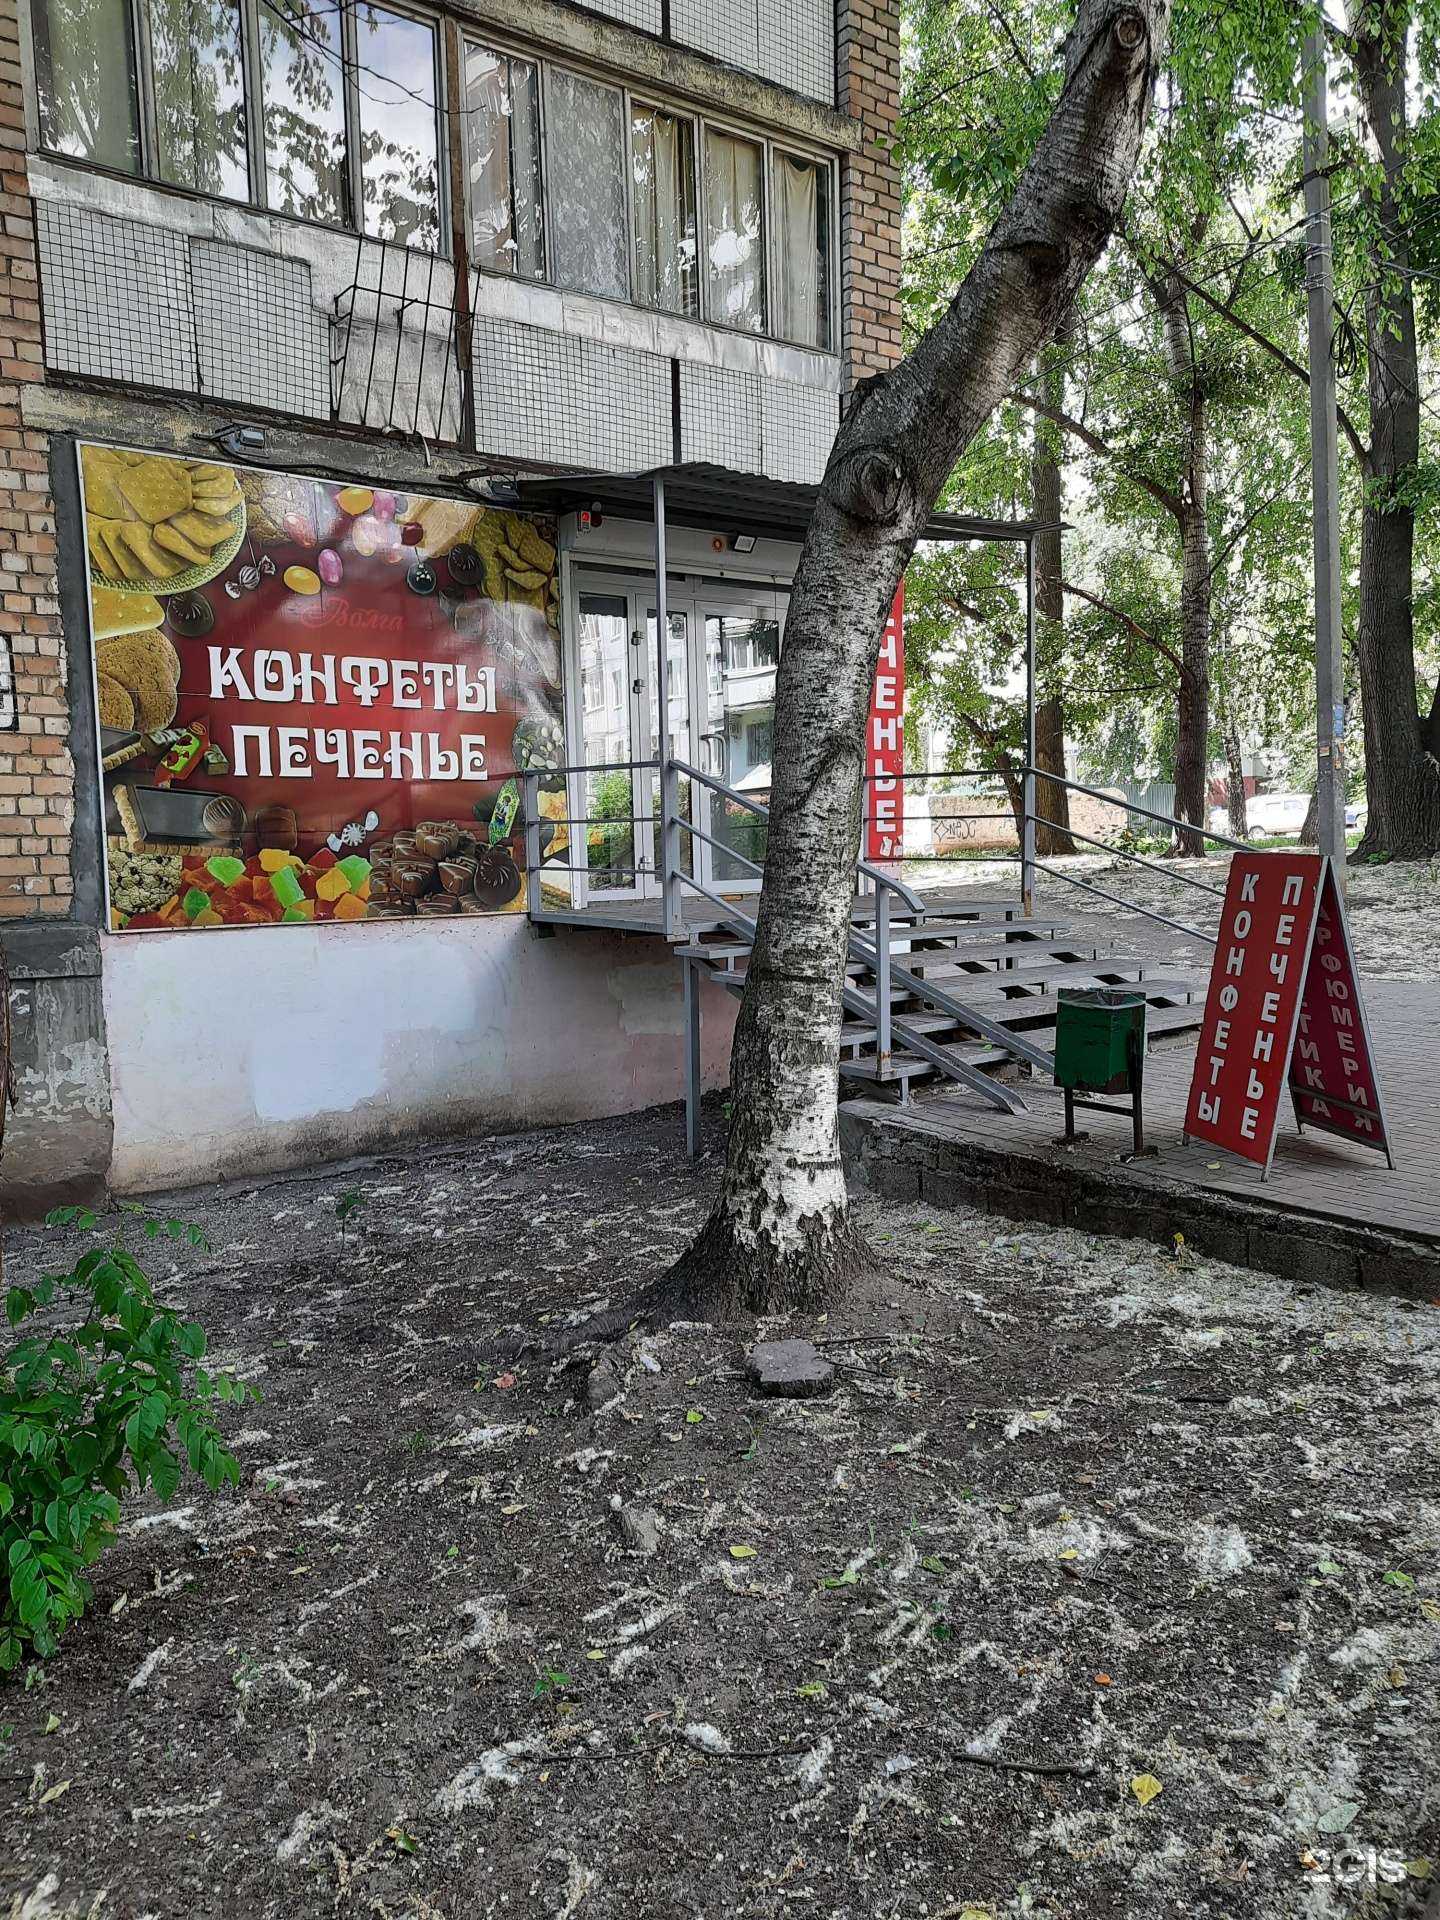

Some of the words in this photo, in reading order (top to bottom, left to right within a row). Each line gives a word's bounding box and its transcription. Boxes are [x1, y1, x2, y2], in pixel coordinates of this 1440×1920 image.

[207, 646, 497, 713] КОНФЕТЫ
[231, 724, 488, 781] ПЕЧЕНЬЕ
[874, 618, 897, 832] ЧЕНЬЕ
[1197, 873, 1260, 1125] КОНФЕТЫ
[1240, 875, 1304, 1139] ПЕЧЕНЬЕ
[1315, 906, 1372, 1132] АРФЮМЕРИЯ
